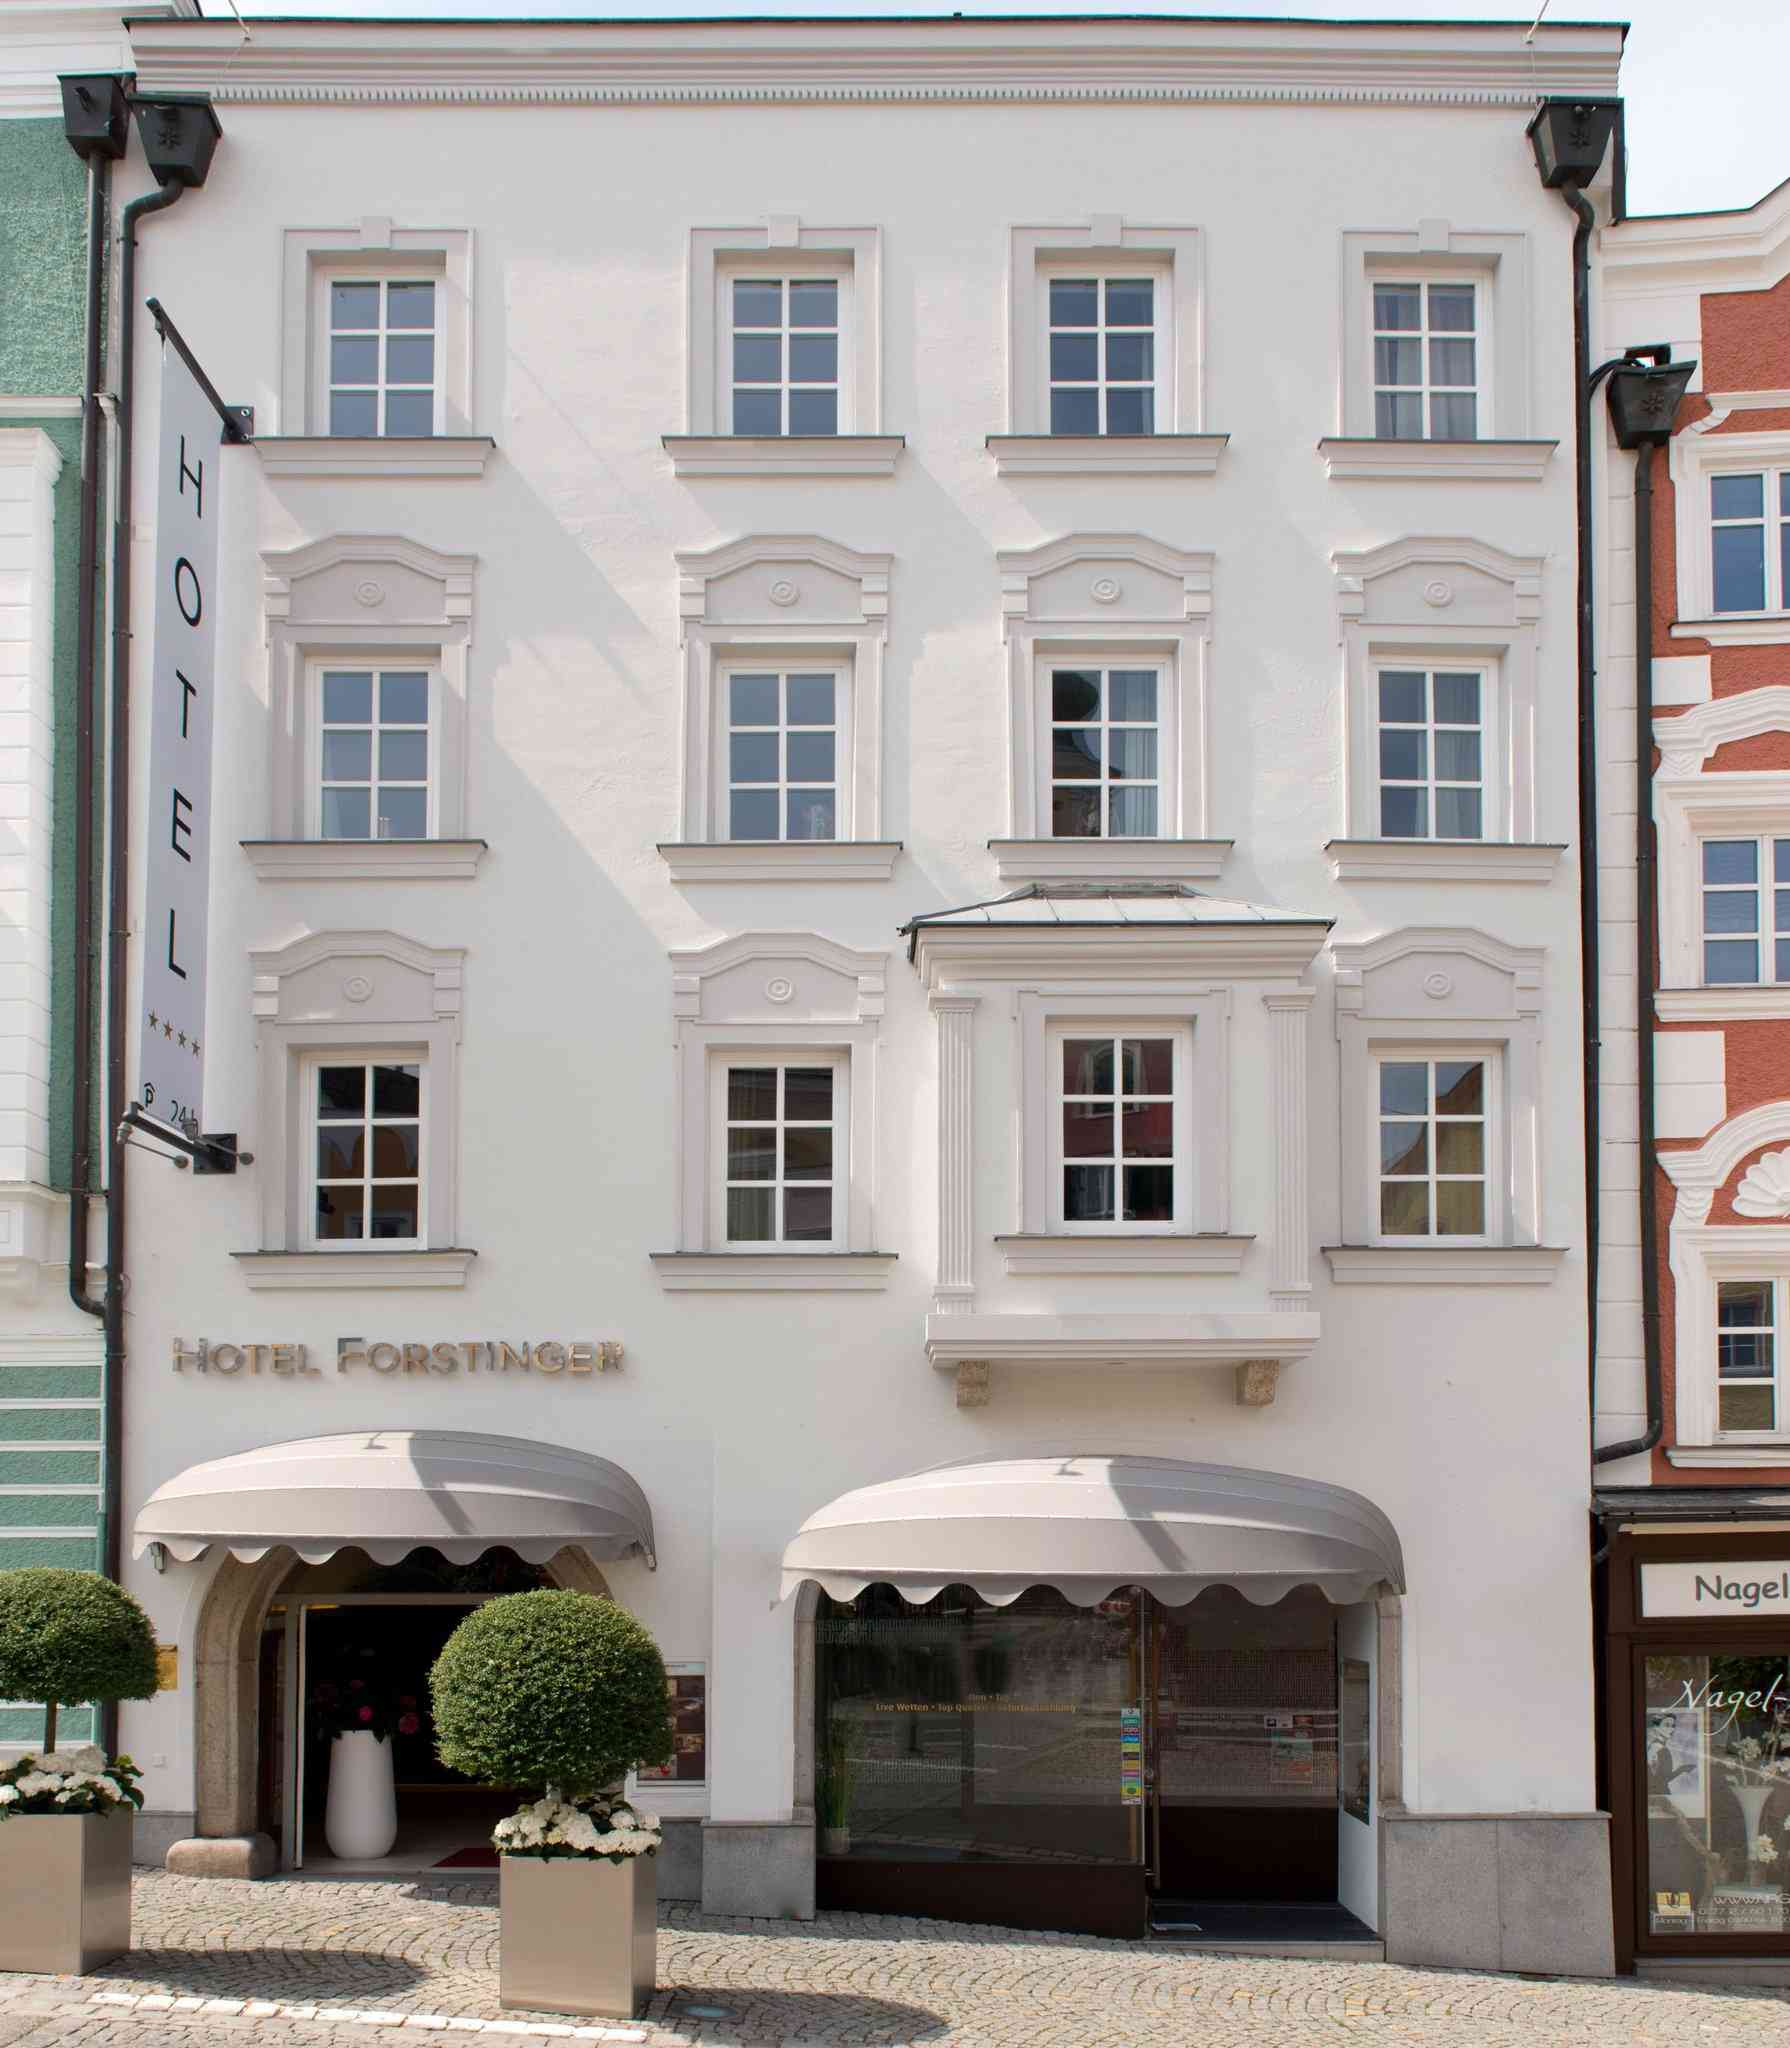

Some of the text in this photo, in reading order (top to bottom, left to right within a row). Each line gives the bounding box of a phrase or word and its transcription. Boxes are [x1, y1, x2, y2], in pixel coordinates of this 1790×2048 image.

[169, 434, 203, 981] HOTEL
[1695, 1572, 1789, 1608] Nagel
[896, 1703, 929, 1713] Wetten
